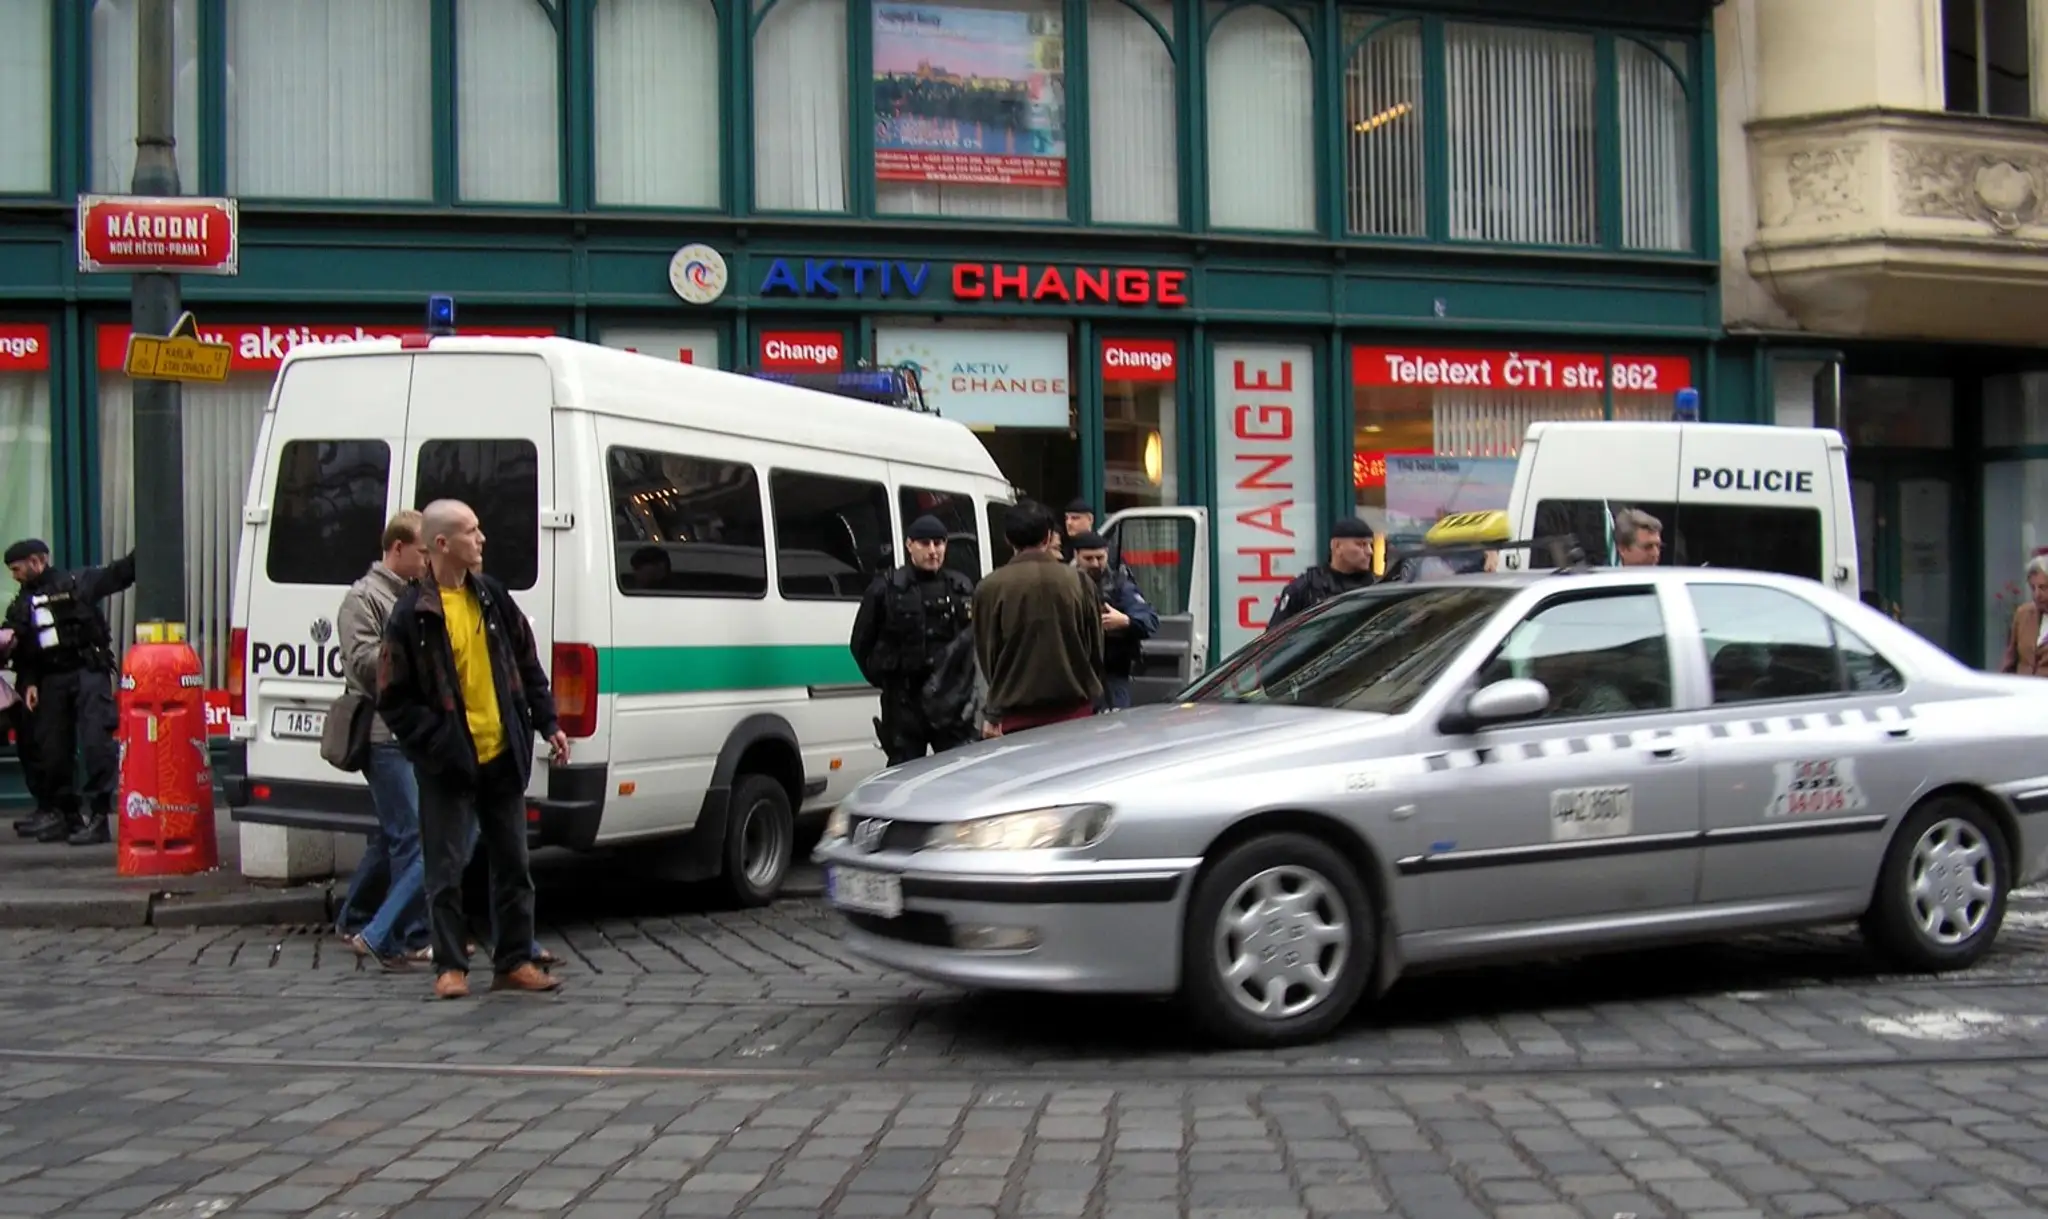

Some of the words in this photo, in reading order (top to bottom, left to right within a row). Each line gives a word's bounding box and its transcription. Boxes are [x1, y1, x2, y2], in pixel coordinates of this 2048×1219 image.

[108, 211, 209, 240] NÁRODNÍ
[760, 258, 930, 297] AKTIV
[951, 263, 1187, 305] CHANGE
[764, 339, 839, 362] Change
[1104, 347, 1173, 371] Change
[951, 362, 1009, 375] AKTIV
[1384, 354, 1492, 385] Teletext
[1503, 351, 1553, 387] ČT1
[1561, 361, 1604, 389] str.
[1610, 363, 1658, 390] 862
[951, 377, 1067, 394] CHANGE
[1692, 467, 1814, 493] POLICIE
[1233, 359, 1297, 630] CHANGE
[288, 713, 313, 732] 1A5
